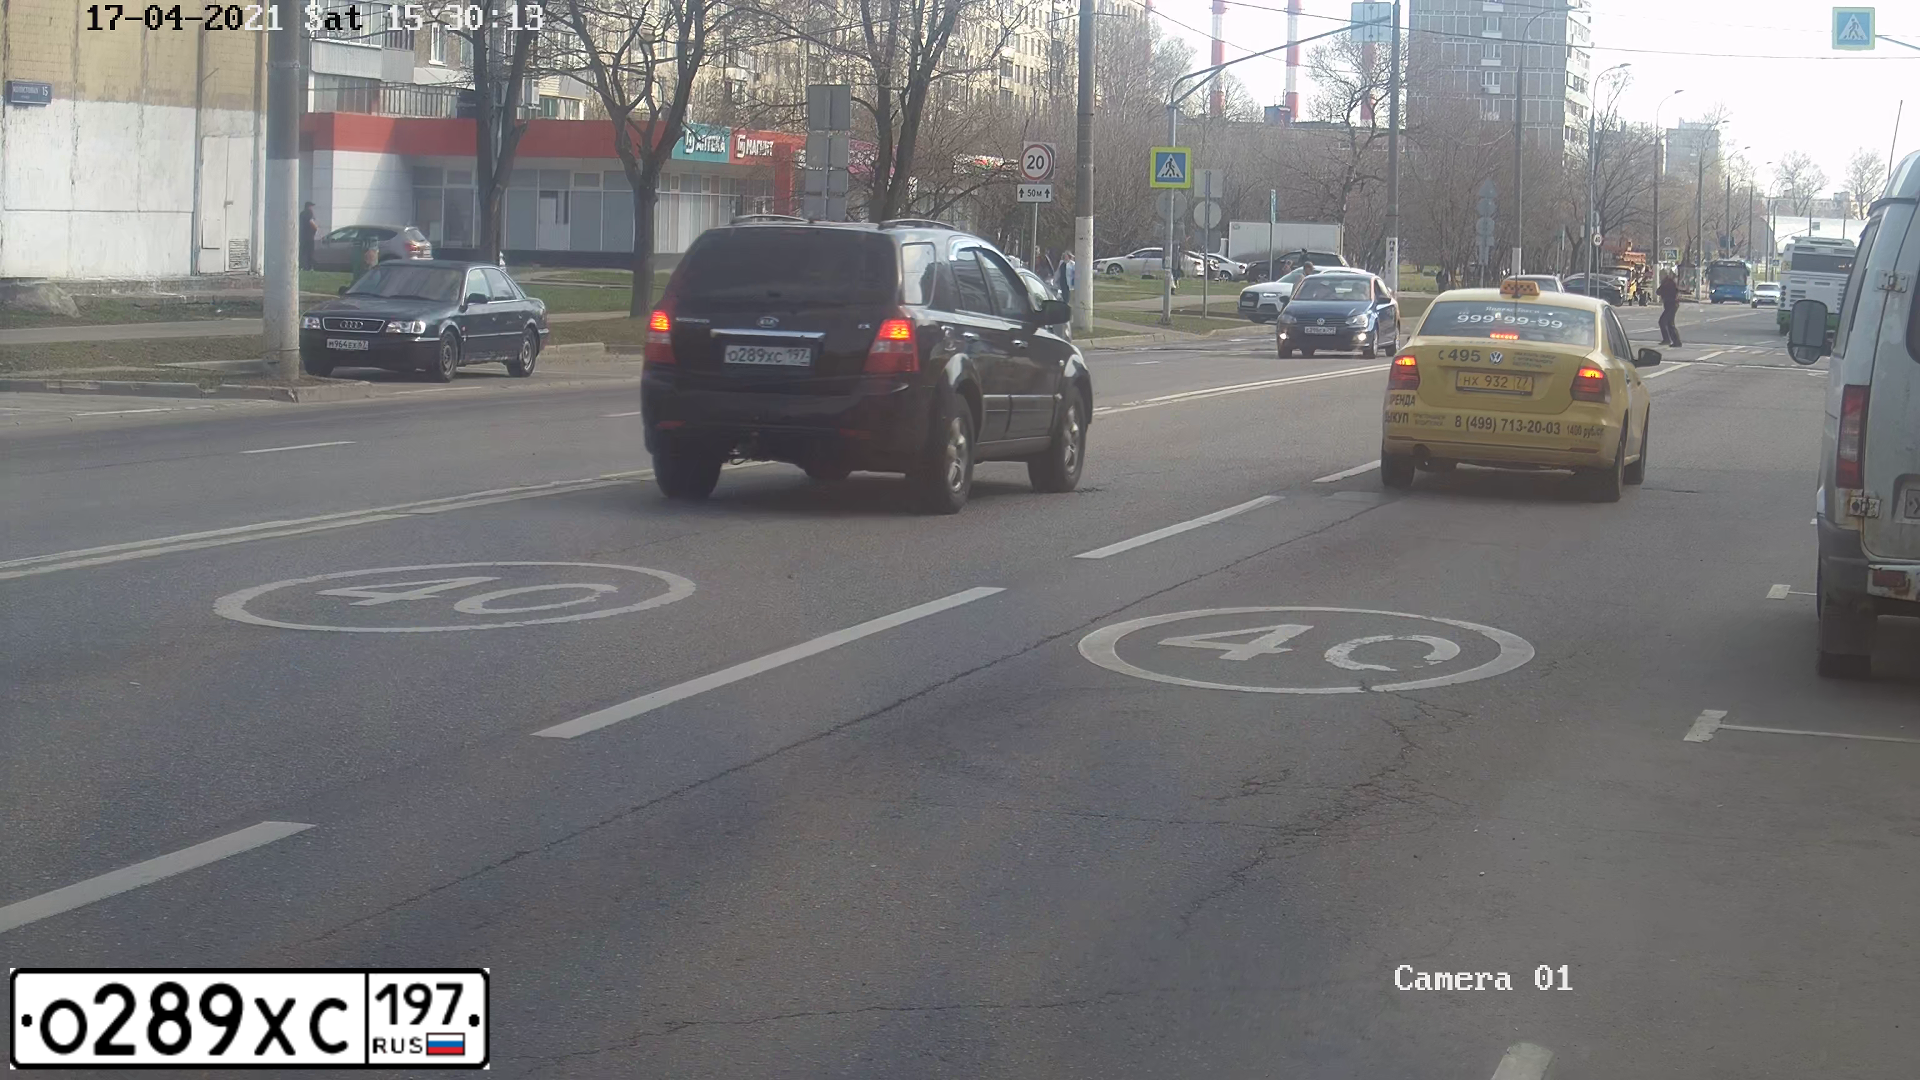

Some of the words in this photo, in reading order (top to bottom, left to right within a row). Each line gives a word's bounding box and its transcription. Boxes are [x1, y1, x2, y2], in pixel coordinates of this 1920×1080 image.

[42, 86, 49, 97] 15
[1026, 154, 1045, 170] 20
[1457, 314, 1563, 329] 999-99-99
[786, 348, 807, 360] 197
[1448, 349, 1481, 362] 495
[1485, 375, 1508, 388] 932
[1516, 376, 1529, 388] 77
[1389, 394, 1416, 407] РЕНДА
[1384, 411, 1409, 424] ЫКУП
[1454, 415, 1462, 428] 8
[1466, 416, 1497, 433] (499)
[1501, 418, 1561, 435] 713-20-03
[316, 576, 619, 615] 40
